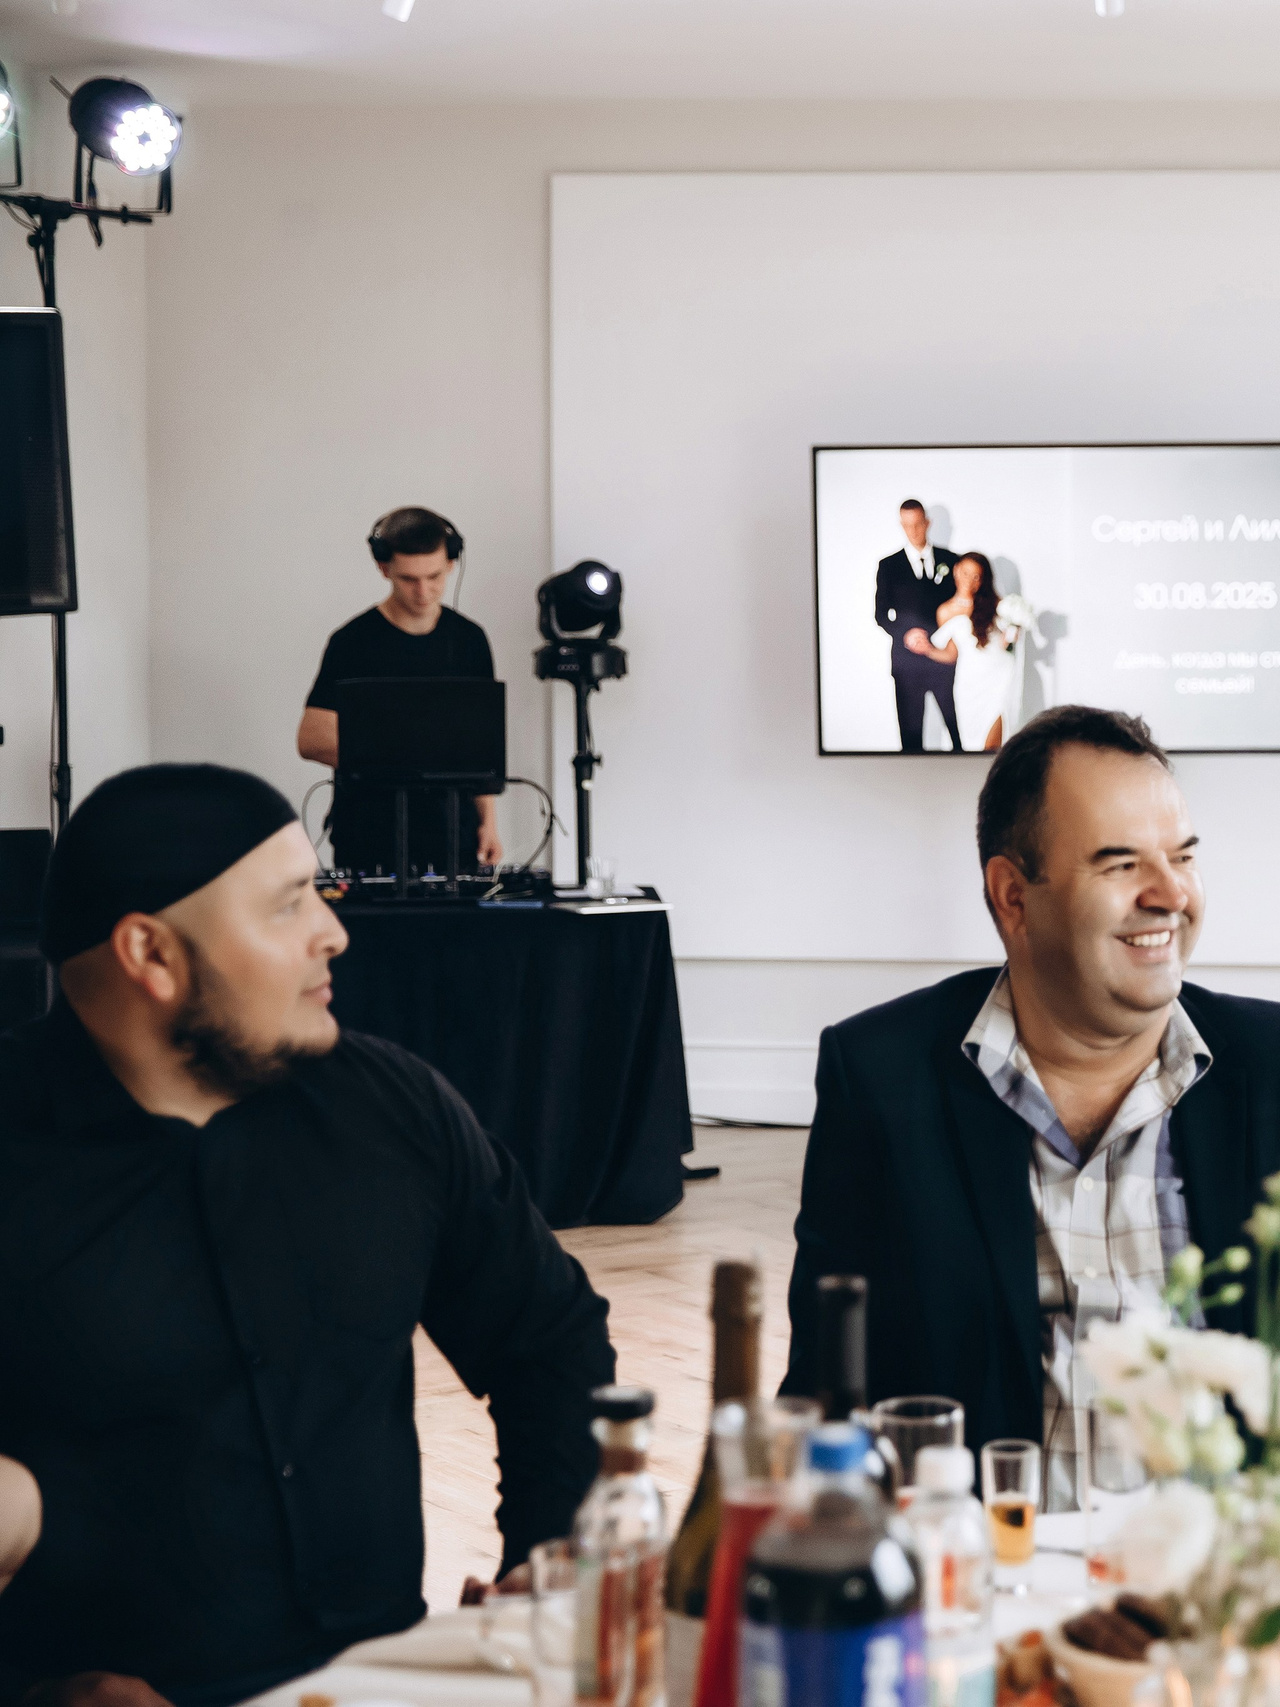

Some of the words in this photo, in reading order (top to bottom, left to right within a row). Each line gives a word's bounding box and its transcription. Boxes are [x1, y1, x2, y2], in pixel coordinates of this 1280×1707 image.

[1092, 514, 1199, 547] Сергей
[1204, 519, 1224, 542] и
[1134, 582, 1278, 610] 30.08.2025
[1227, 652, 1258, 668] мы
